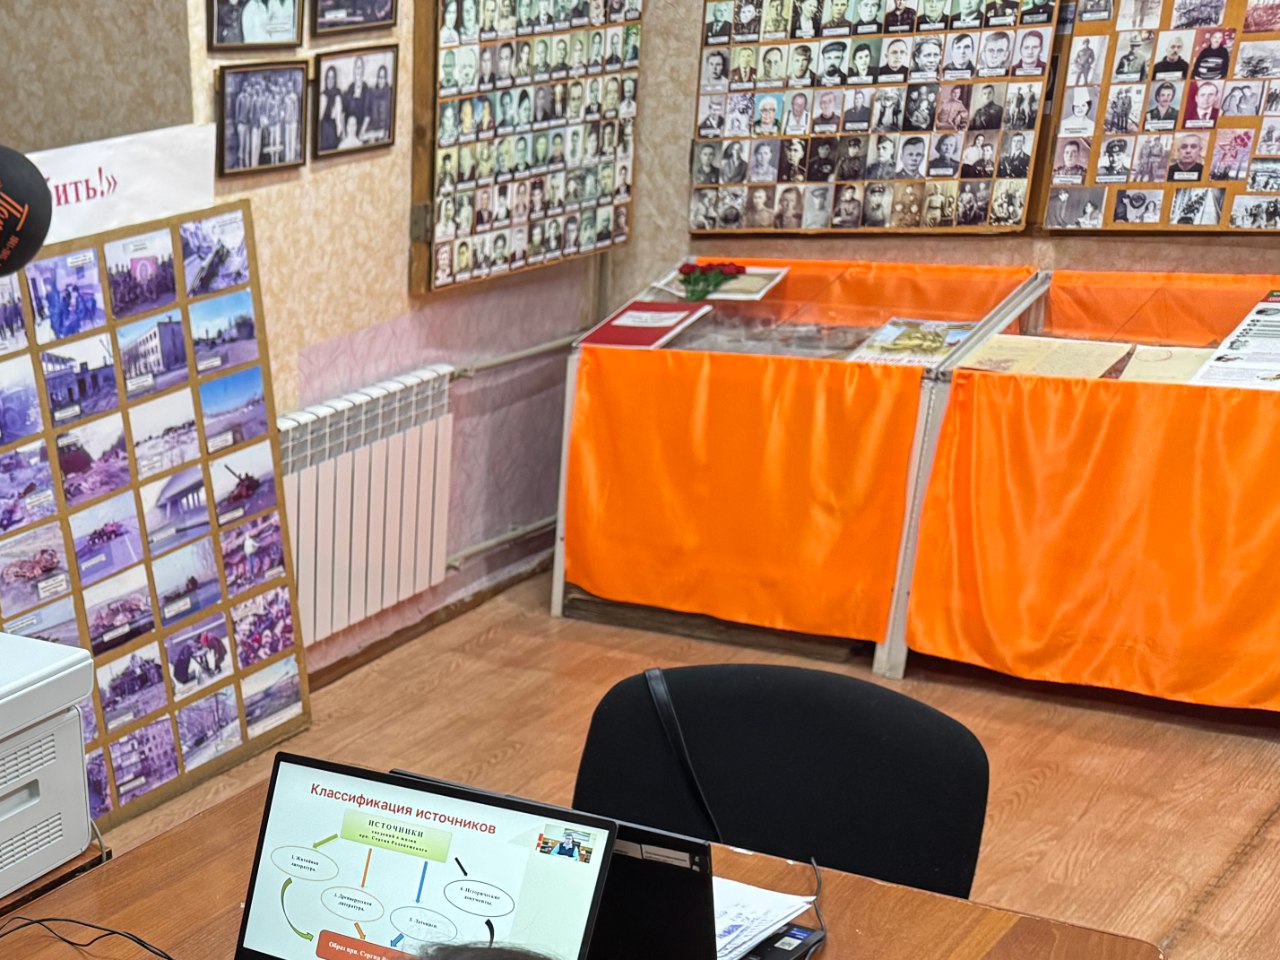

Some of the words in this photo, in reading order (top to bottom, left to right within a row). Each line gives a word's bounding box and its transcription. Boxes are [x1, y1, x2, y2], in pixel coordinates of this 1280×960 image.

[51, 166, 118, 207] ить!»
[310, 783, 413, 817] Классификация
[415, 808, 496, 835] источников
[368, 819, 424, 838] ИСТОЧНИКИ
